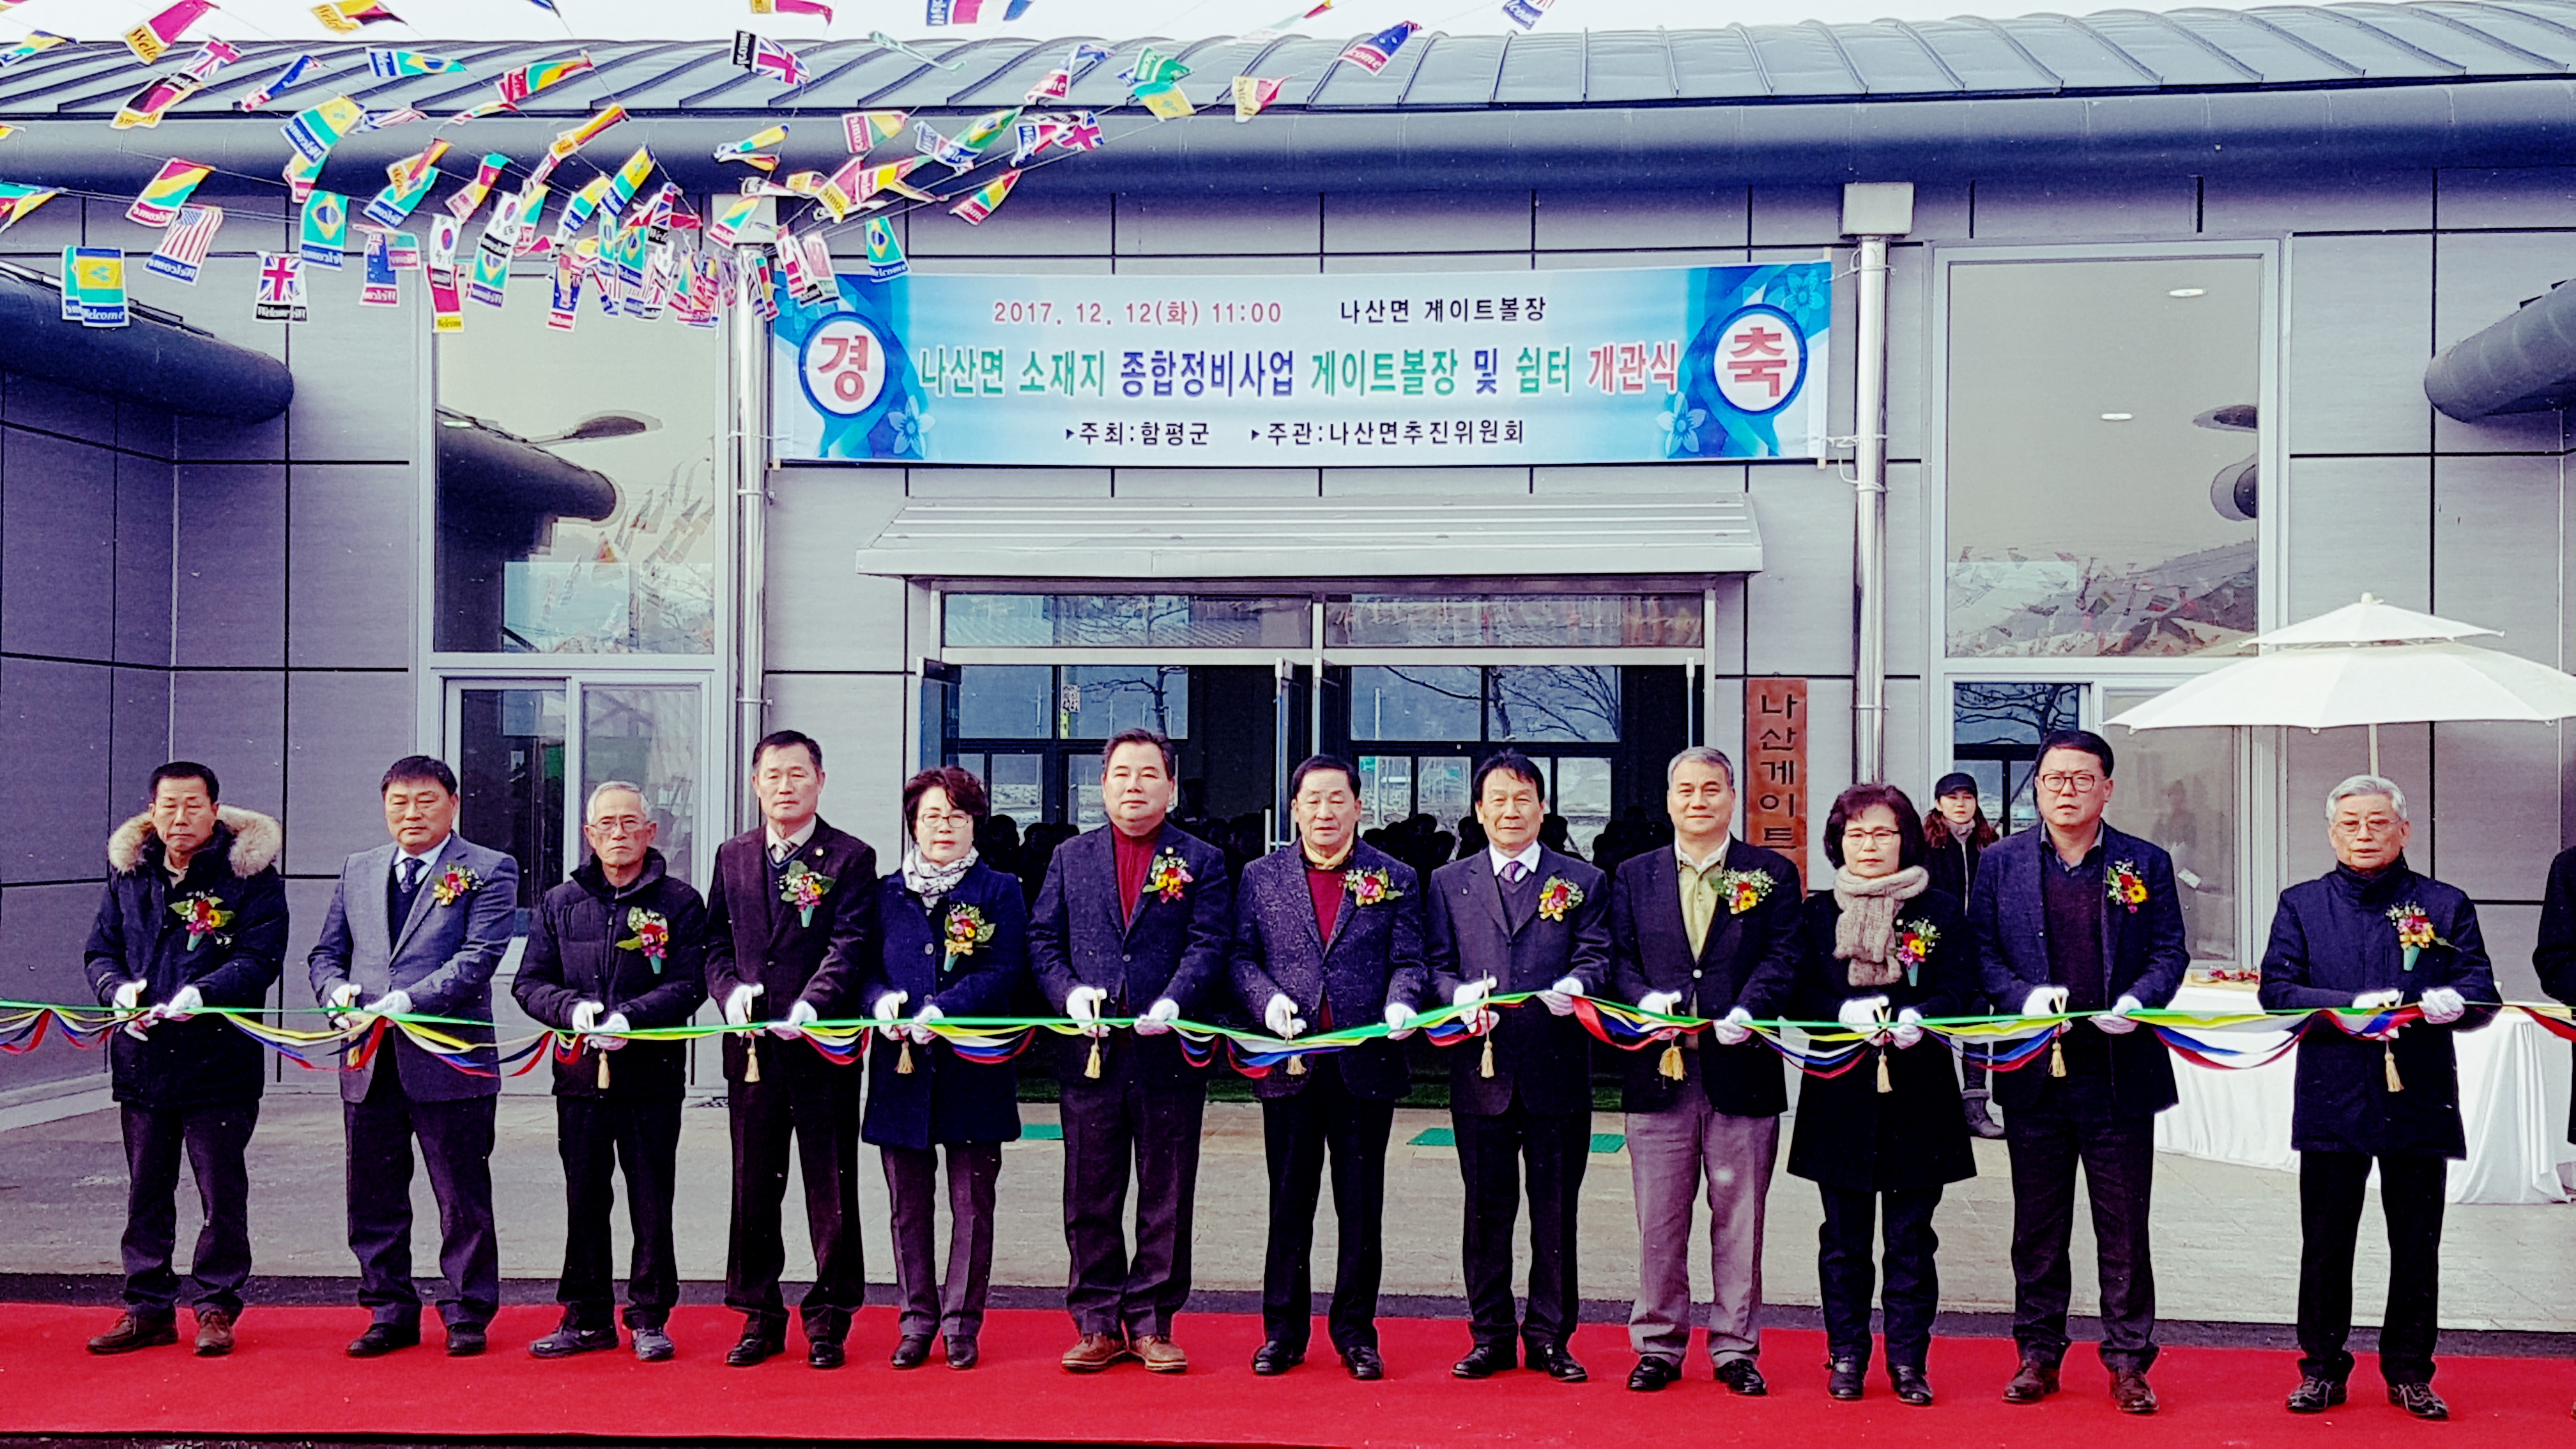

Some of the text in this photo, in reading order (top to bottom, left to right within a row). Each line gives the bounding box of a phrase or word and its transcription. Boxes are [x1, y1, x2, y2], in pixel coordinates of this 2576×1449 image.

[994, 300, 1282, 326] 2017. 12. 12(화) 11:00
[1340, 296, 1547, 325] 나산면 게이트볼장
[818, 335, 869, 402] 경
[921, 341, 1679, 398] 나산면 소재지 종합정비사업 게이트볼장 및 쉼터 개관식
[1726, 326, 1788, 397] 축
[1759, 693, 1798, 850] 나산게이트
